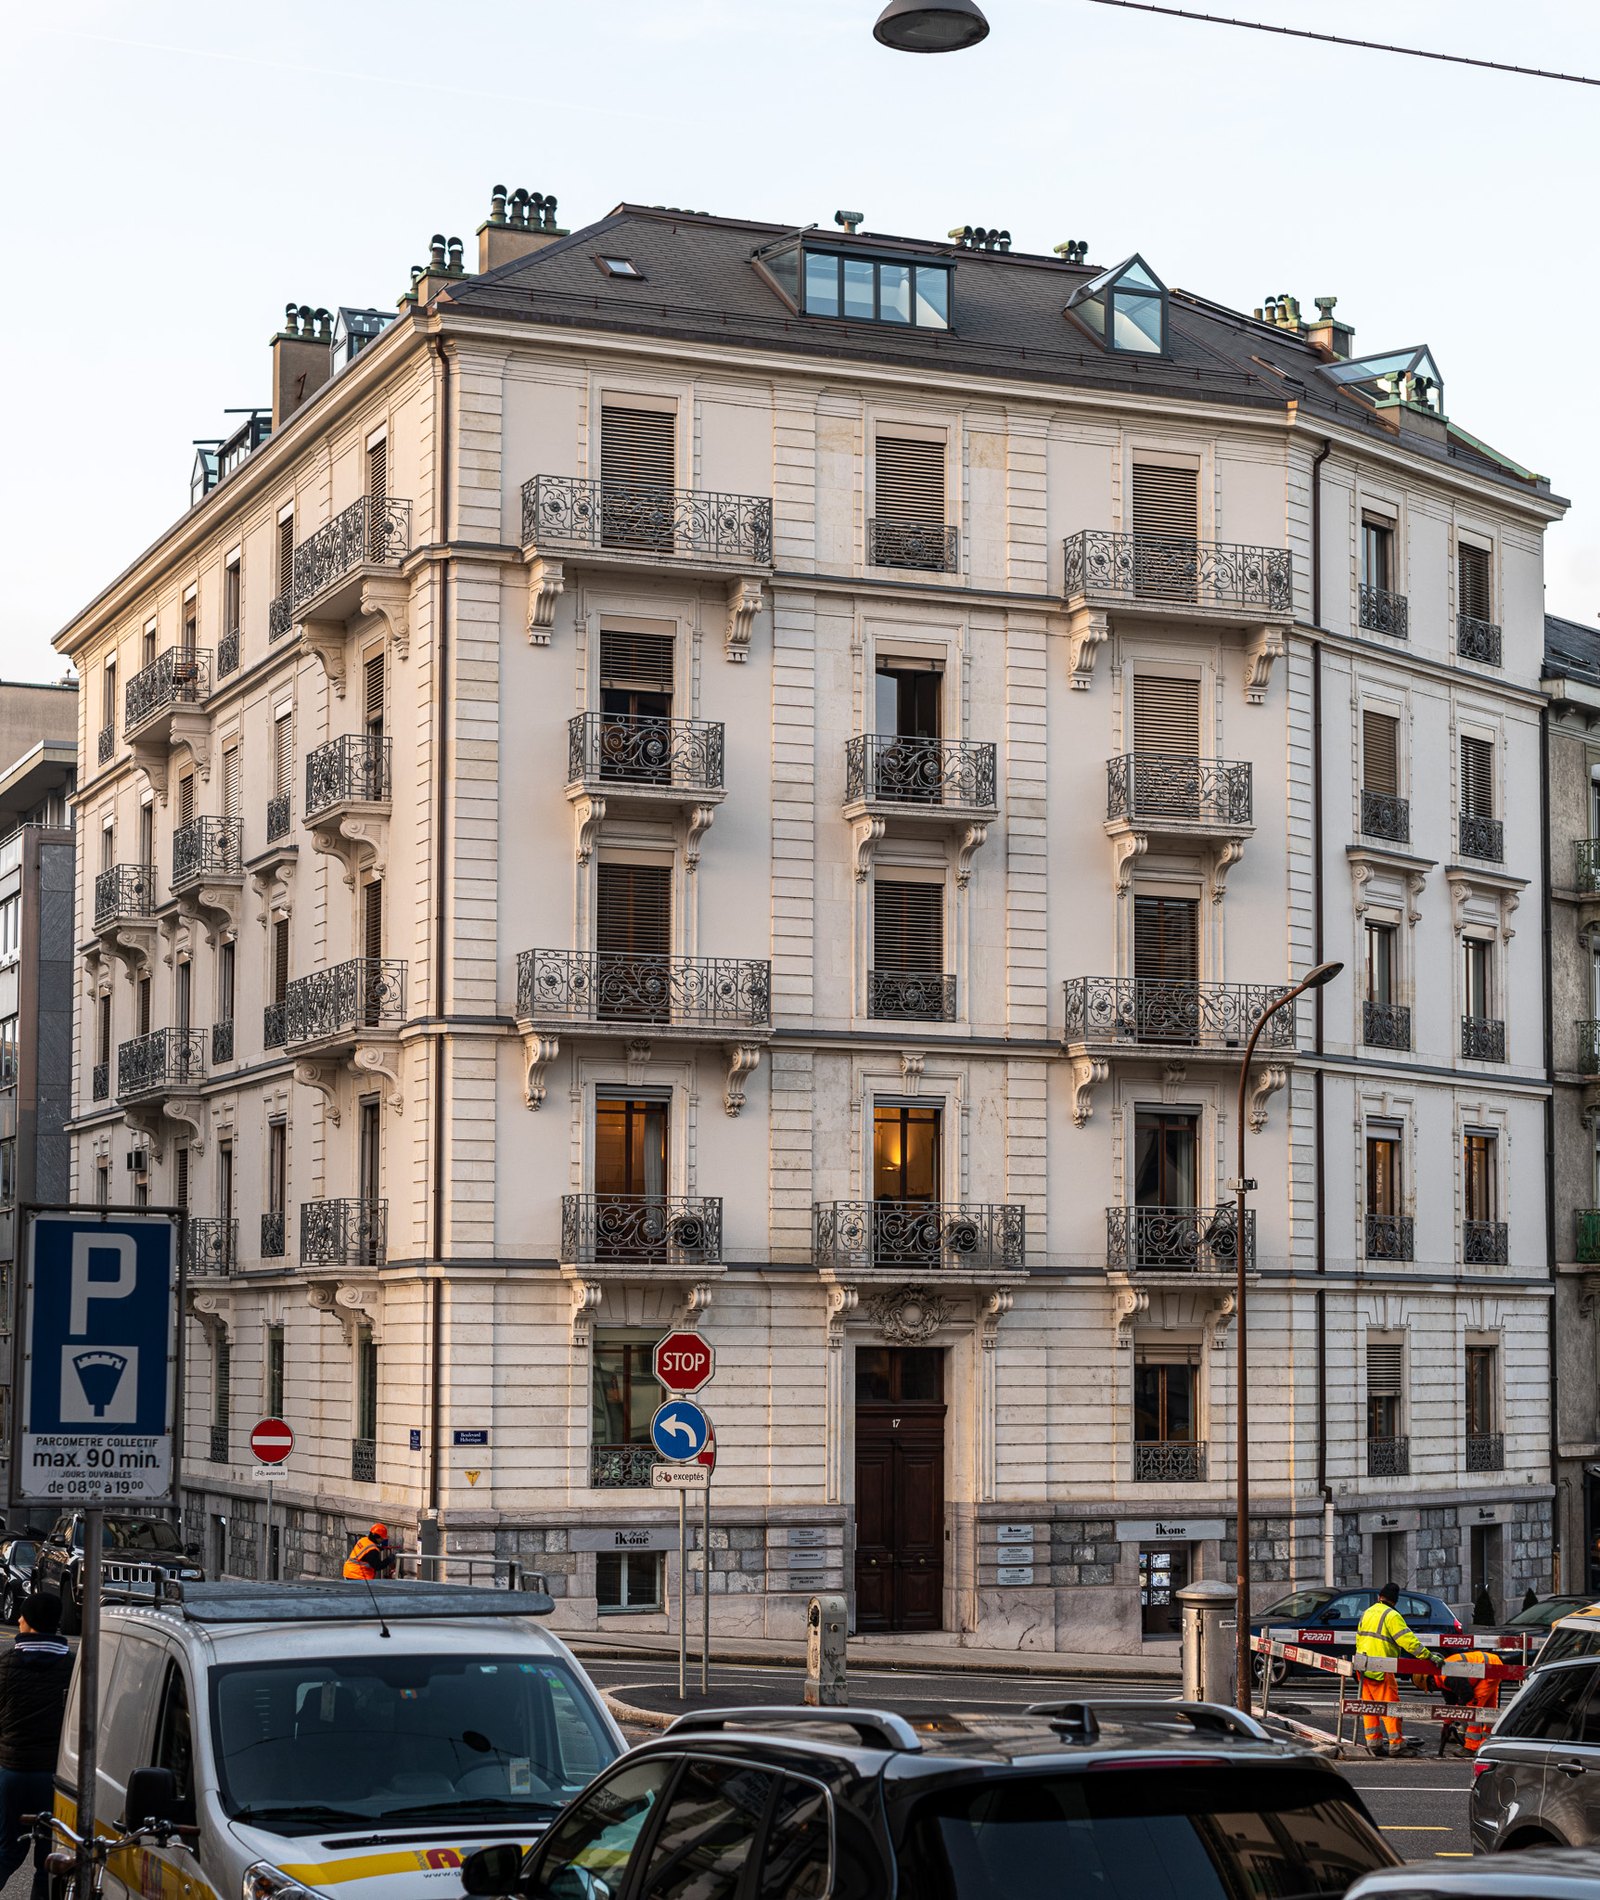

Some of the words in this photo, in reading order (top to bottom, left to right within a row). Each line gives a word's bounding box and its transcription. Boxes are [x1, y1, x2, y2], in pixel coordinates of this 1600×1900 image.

[69, 1231, 138, 1335] P
[662, 1352, 705, 1372] STOP
[892, 1418, 901, 1428] 17
[36, 1437, 103, 1447] PARCOMETRE
[107, 1438, 159, 1448] COLLECTIF
[32, 1452, 81, 1468] max.
[86, 1448, 115, 1468] 90
[119, 1450, 160, 1468] min.
[60, 1470, 86, 1478] JOURS
[88, 1471, 132, 1479] OUVRABLES
[673, 1472, 704, 1482] exceptés
[48, 1481, 64, 1493] de
[104, 1481, 112, 1494] à
